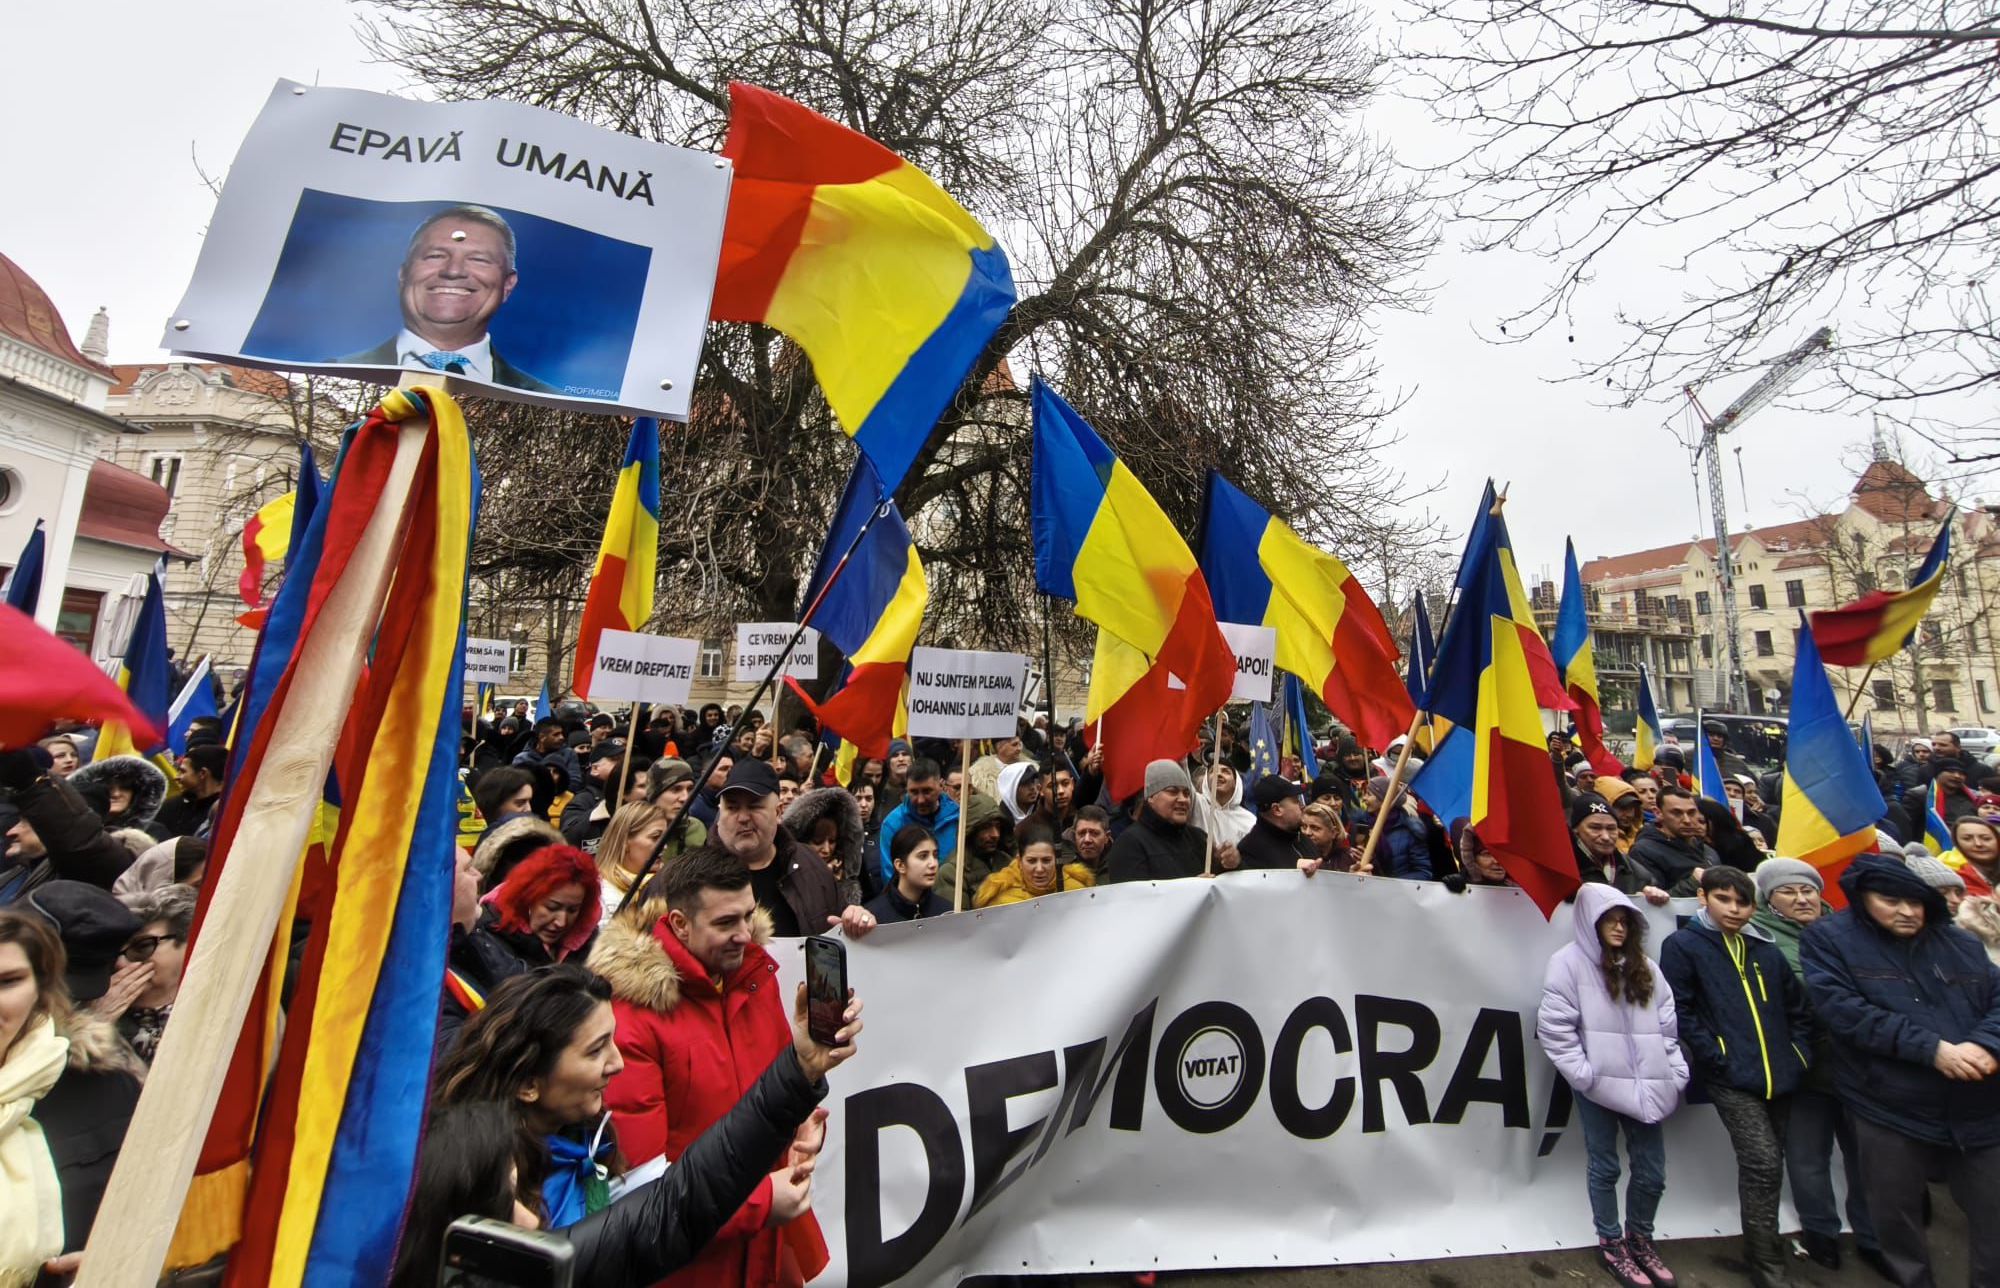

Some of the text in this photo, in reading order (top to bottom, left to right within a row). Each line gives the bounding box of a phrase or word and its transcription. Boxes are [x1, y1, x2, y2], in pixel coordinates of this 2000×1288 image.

[330, 122, 655, 207] EPAVĂ UMANĂ
[564, 385, 619, 398] PROFIMEDIA
[748, 633, 760, 646] CE
[761, 633, 787, 646] VREM
[479, 663, 488, 673] DE
[600, 655, 691, 680] VREM DREPTATE!
[740, 653, 814, 670] E ȘI PENTU VOI!
[916, 671, 1015, 691] NU SUNTEM PLEAVA,
[912, 698, 1015, 717] IOHANNIS LA JILAVA!
[1185, 1055, 1239, 1079] VOTAT
